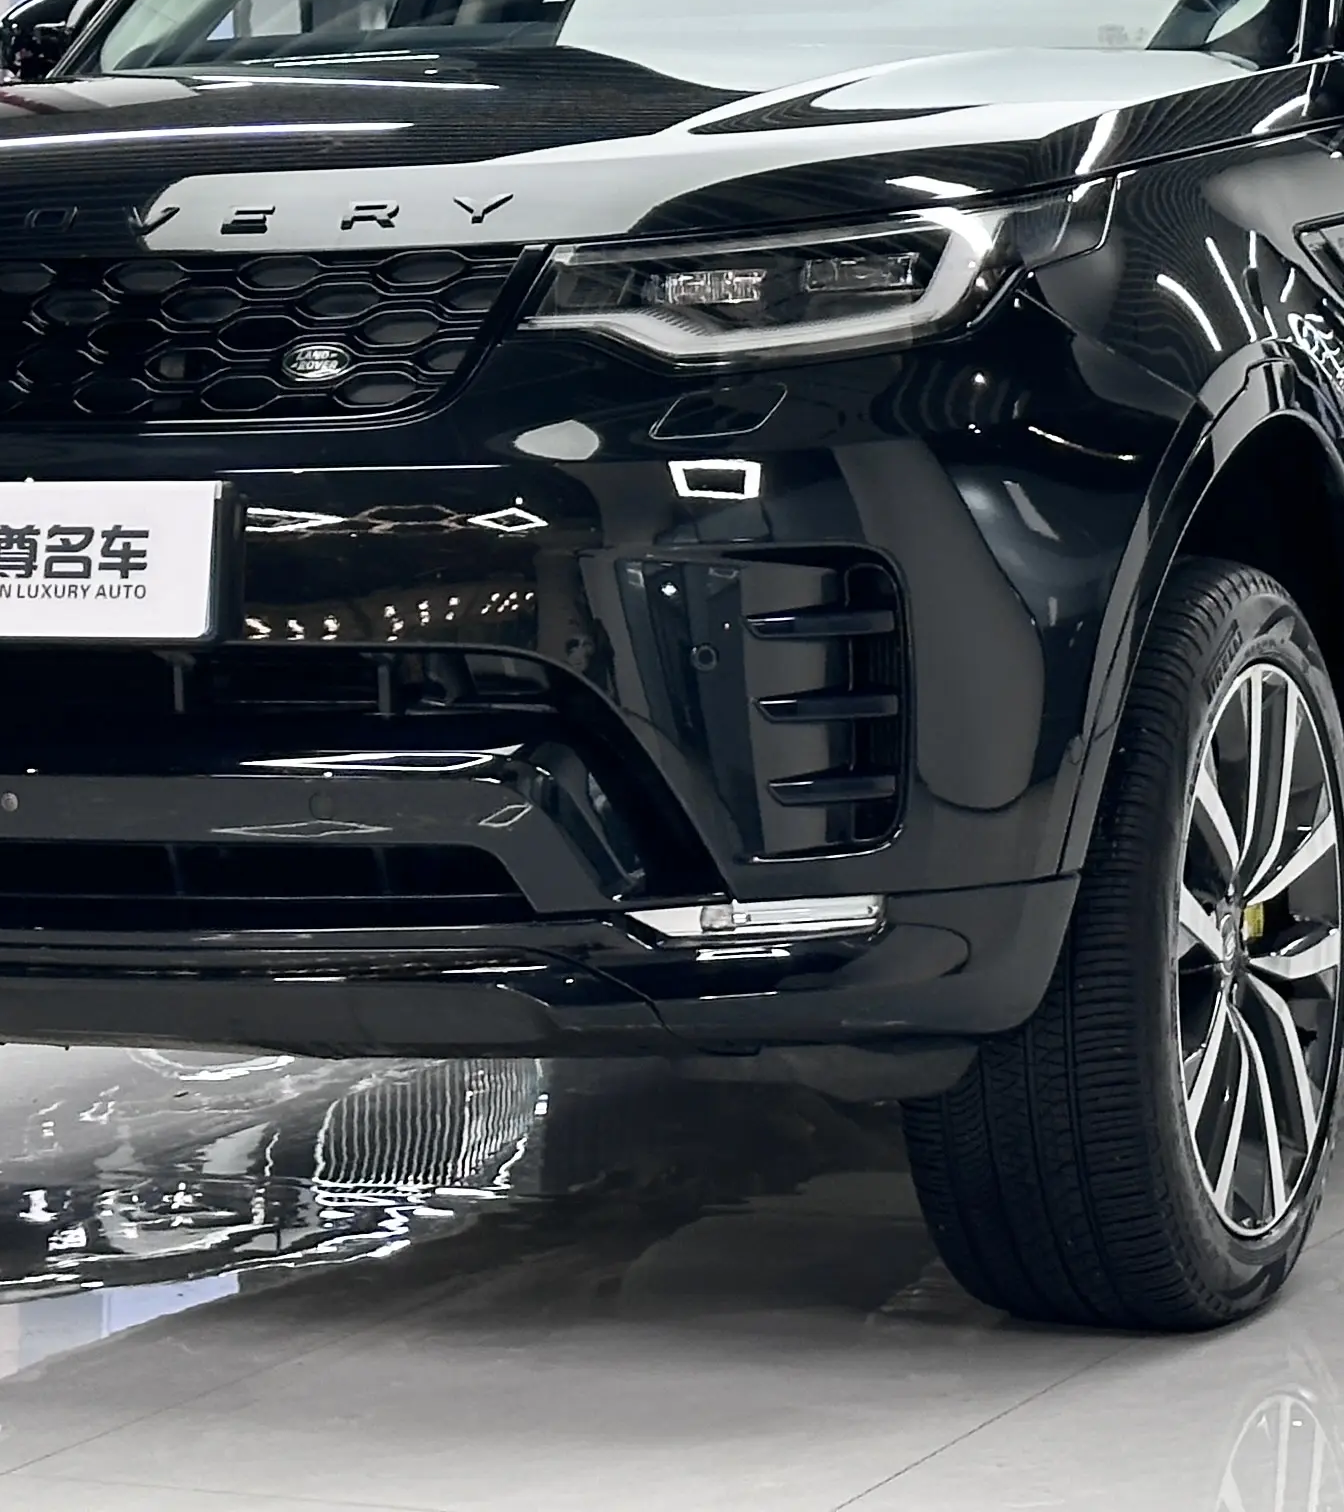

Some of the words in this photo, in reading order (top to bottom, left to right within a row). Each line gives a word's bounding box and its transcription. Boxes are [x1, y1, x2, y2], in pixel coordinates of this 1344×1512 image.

[296, 350, 331, 360] LAND
[296, 360, 339, 371] ROVER
[17, 583, 91, 599] LUXURY
[94, 583, 147, 599] AUTO
